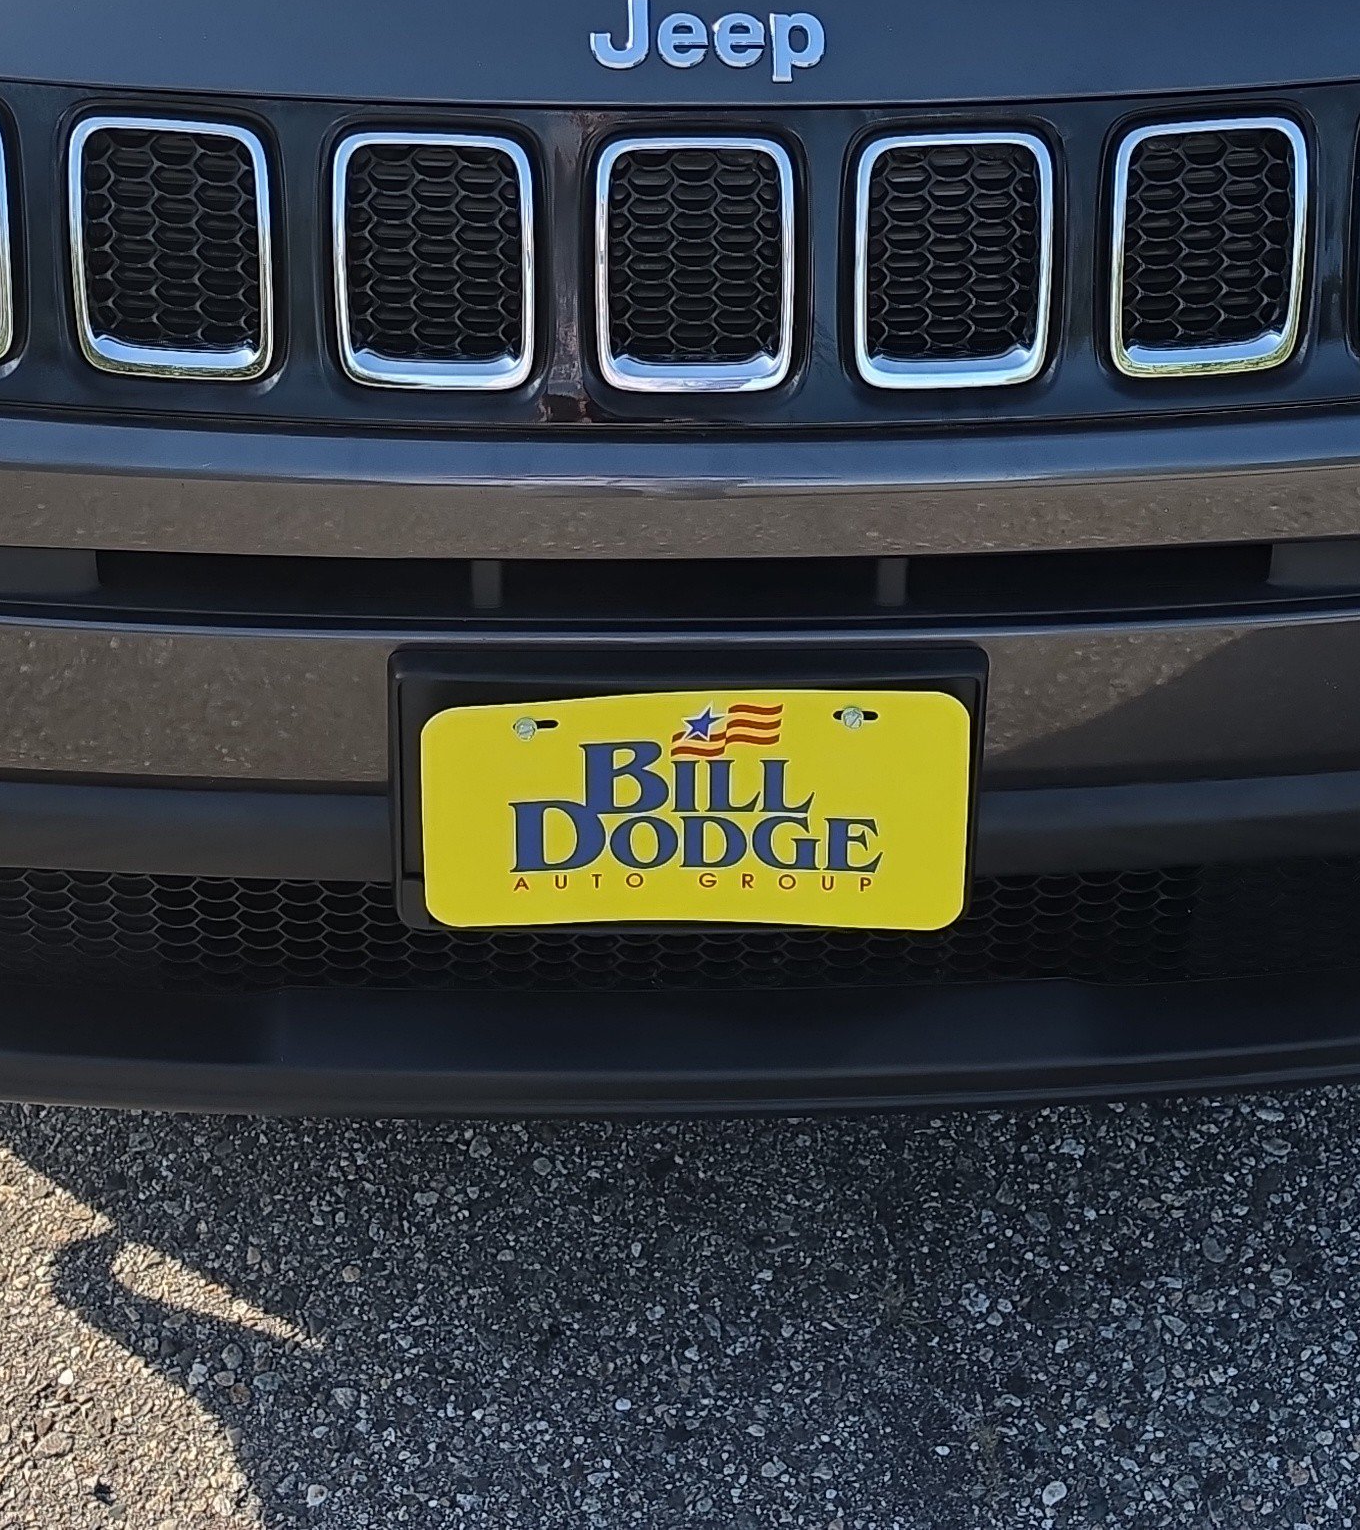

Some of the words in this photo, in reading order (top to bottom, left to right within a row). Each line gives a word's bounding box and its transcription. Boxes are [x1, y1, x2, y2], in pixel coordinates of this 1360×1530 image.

[579, 740, 816, 814] BILL
[508, 799, 884, 874] DODGE
[513, 872, 645, 892] AUTO
[698, 872, 874, 892] GROUP
